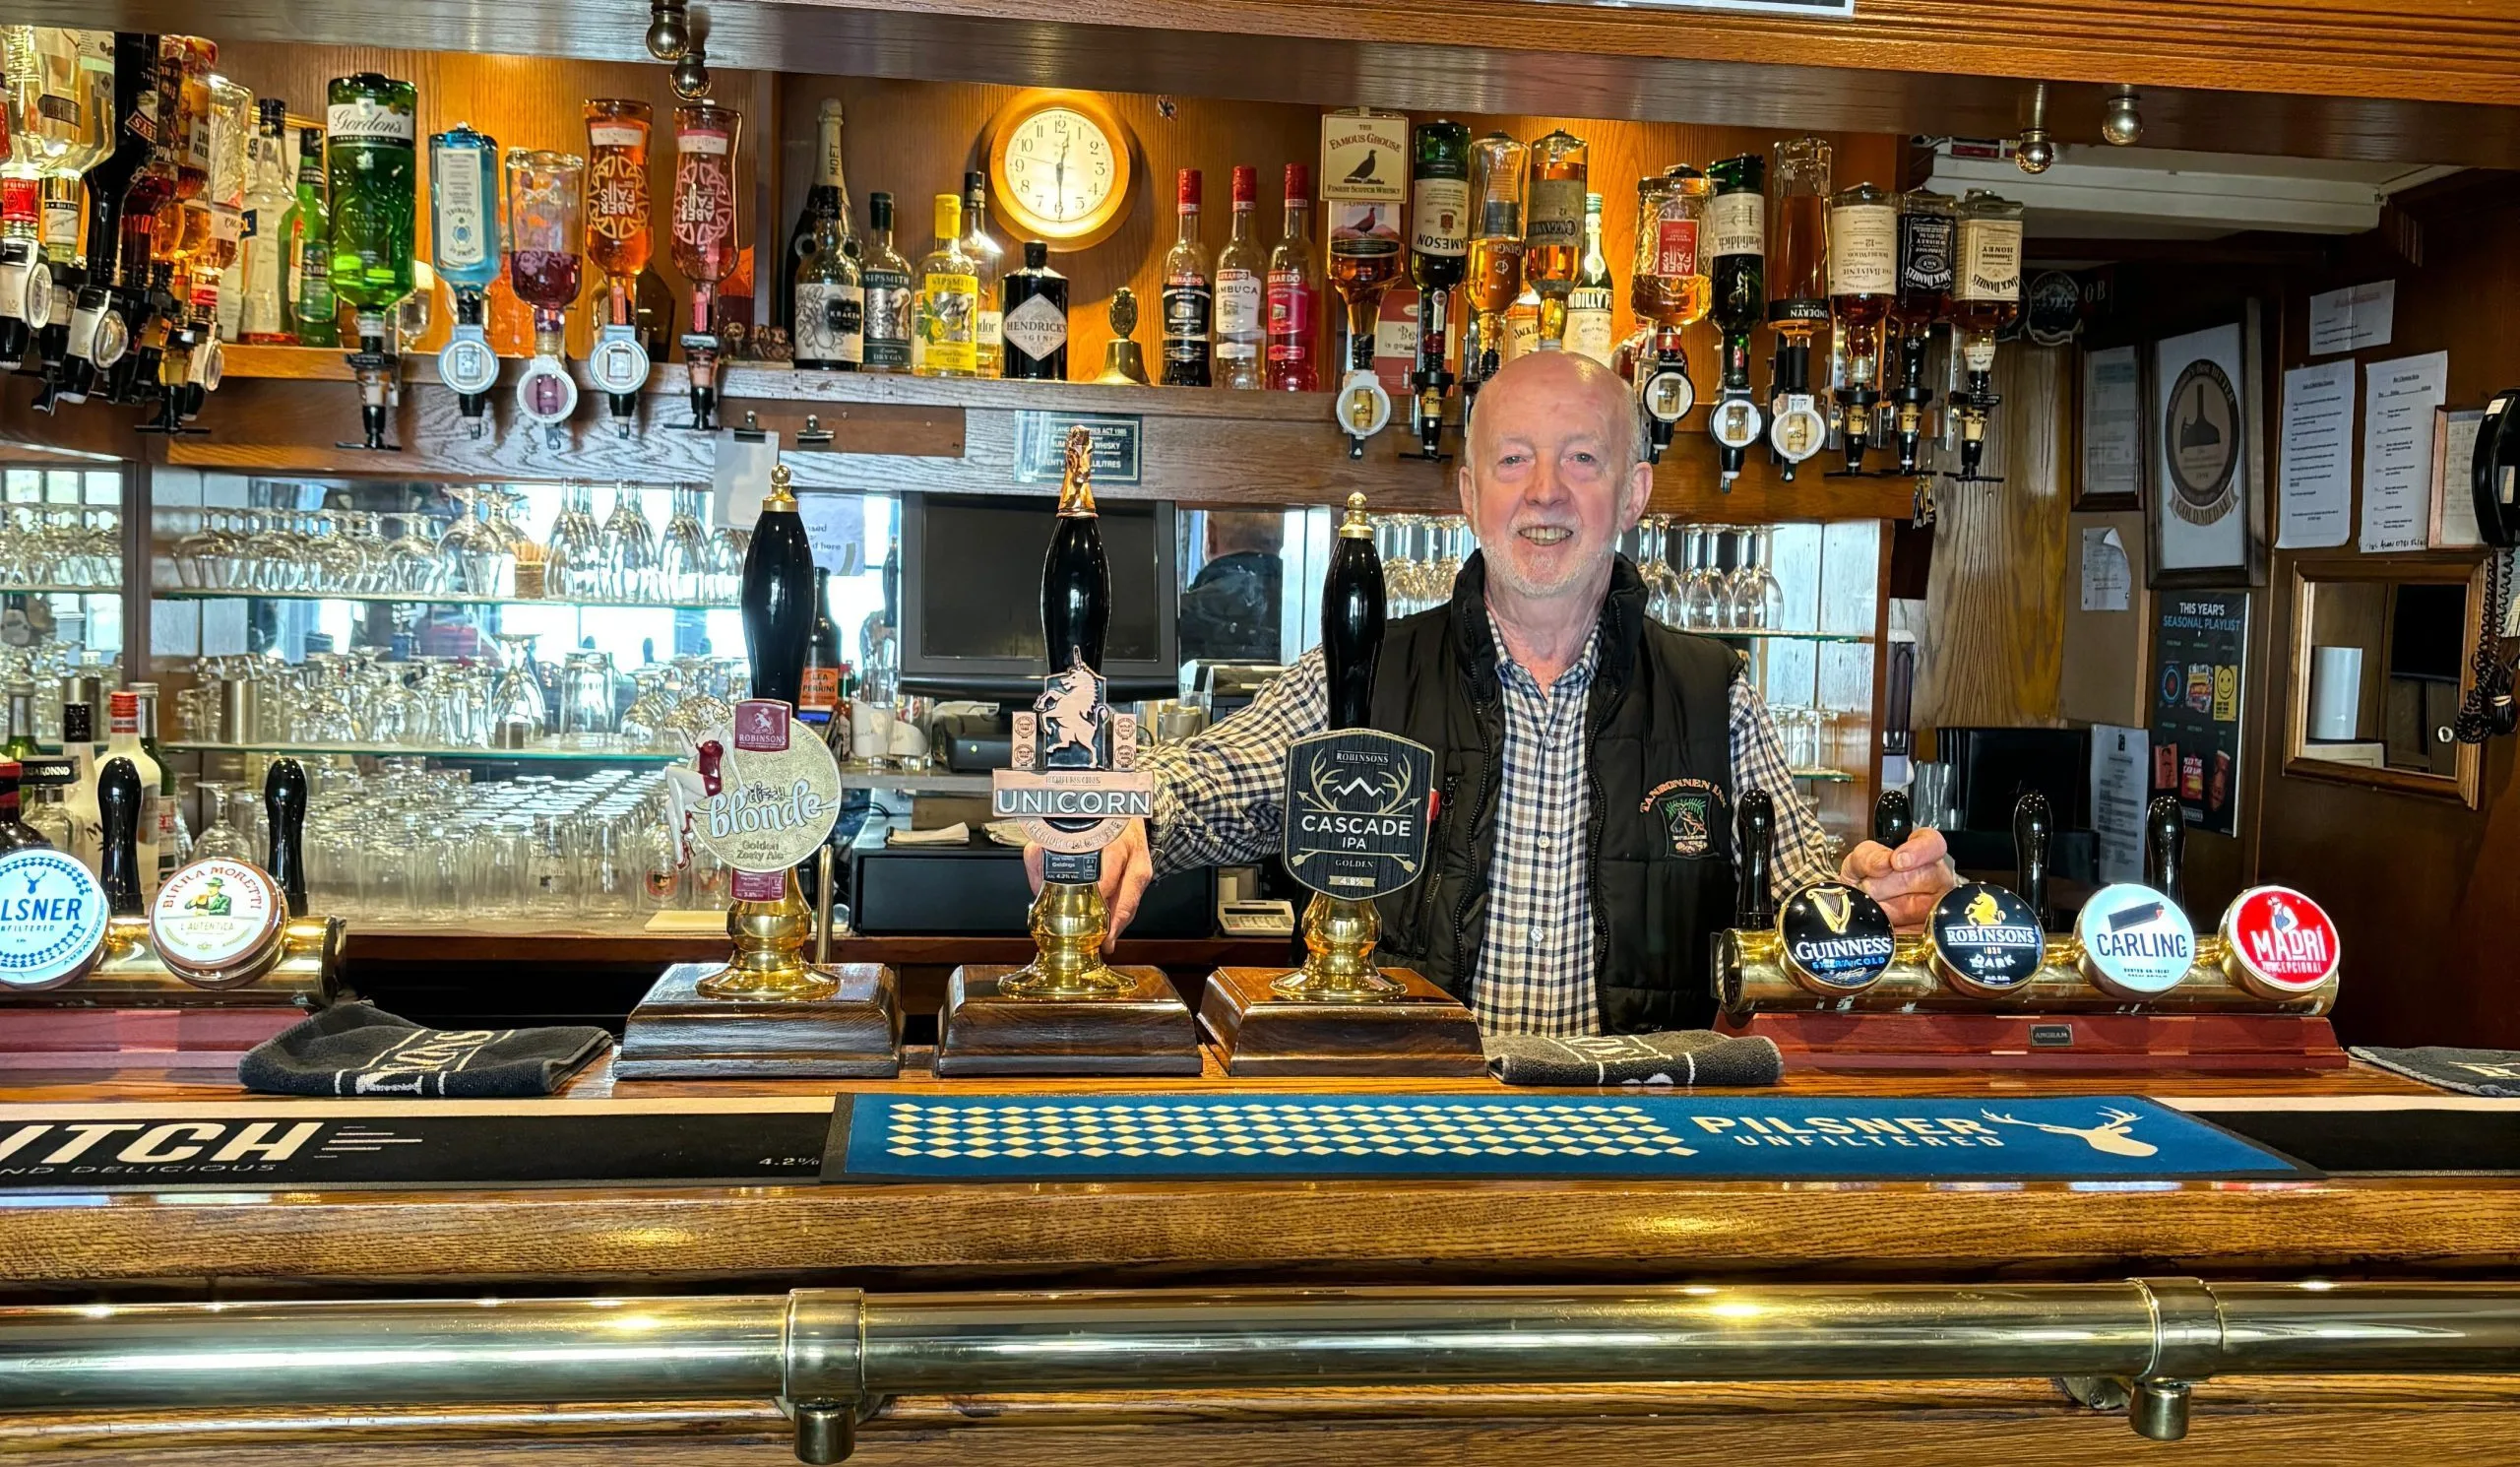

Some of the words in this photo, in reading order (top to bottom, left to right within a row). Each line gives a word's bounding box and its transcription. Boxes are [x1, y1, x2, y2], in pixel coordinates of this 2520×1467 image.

[334, 109, 402, 134] Gordon's
[1054, 119, 1067, 134] 12
[1037, 124, 1043, 138] 11
[1021, 138, 1034, 153] 10
[1089, 141, 1099, 155] 2
[1329, 134, 1366, 151] FAMOUS
[1367, 133, 1402, 154] GROUSE
[1015, 159, 1025, 172] 9
[1095, 161, 1105, 176] 3
[1020, 179, 1030, 193] 8
[1088, 182, 1099, 196] 4
[1036, 194, 1044, 208] 7
[1075, 196, 1085, 210] 5
[600, 201, 636, 216] ABER
[681, 209, 715, 222] ABER
[1662, 248, 1691, 263] FALLS
[1662, 262, 1691, 273] ABER
[865, 274, 910, 285] SIPSMITH
[1169, 276, 1203, 285] LUXARDO
[1905, 266, 1933, 287] DANIEL'S
[1933, 269, 1952, 286] JACK
[1972, 274, 2000, 293] DANIEL'S
[2001, 276, 2018, 291] JACK
[1217, 286, 1258, 295] AMBUCA
[830, 310, 860, 320] KRAKEN
[1007, 321, 1067, 334] HENDRICK'S
[2179, 602, 2197, 614] THIS
[2197, 603, 2225, 616] YEAR'S
[2163, 615, 2203, 629] SEASONAL
[2204, 618, 2240, 631] PLAYLIST
[803, 684, 836, 693] PERRINS
[738, 734, 787, 743] ROBINSONS
[1336, 752, 1389, 764] ROBINSONS
[710, 778, 823, 838] blonde
[996, 790, 1151, 814] UNICORN
[1301, 814, 1412, 837] CASCADE
[741, 839, 780, 851] Golden
[1342, 837, 1366, 850] IPA
[736, 850, 765, 861] Zesty
[767, 850, 784, 861] Ale
[1335, 859, 1373, 867] GOLDEN
[163, 869, 206, 909] BIRRA
[211, 866, 262, 910] MORETTI
[1339, 877, 1364, 886] 4.8%
[0, 898, 83, 921] LSNER
[1945, 929, 2036, 943] ROBINSONS
[1796, 937, 1892, 960] GUINNESS
[2096, 933, 2187, 958] CARLING
[2250, 925, 2327, 962] MADRÍ
[1856, 956, 1885, 966] COLD
[1970, 954, 2016, 969] DARK
[1690, 1116, 1998, 1134] PILSNER
[0, 1121, 325, 1165] ITCH
[1733, 1135, 2005, 1147] UNFILTERED
[759, 1157, 820, 1166] 4.2%
[1, 1166, 55, 1175] ND
[71, 1164, 277, 1174] DELICIOUS
